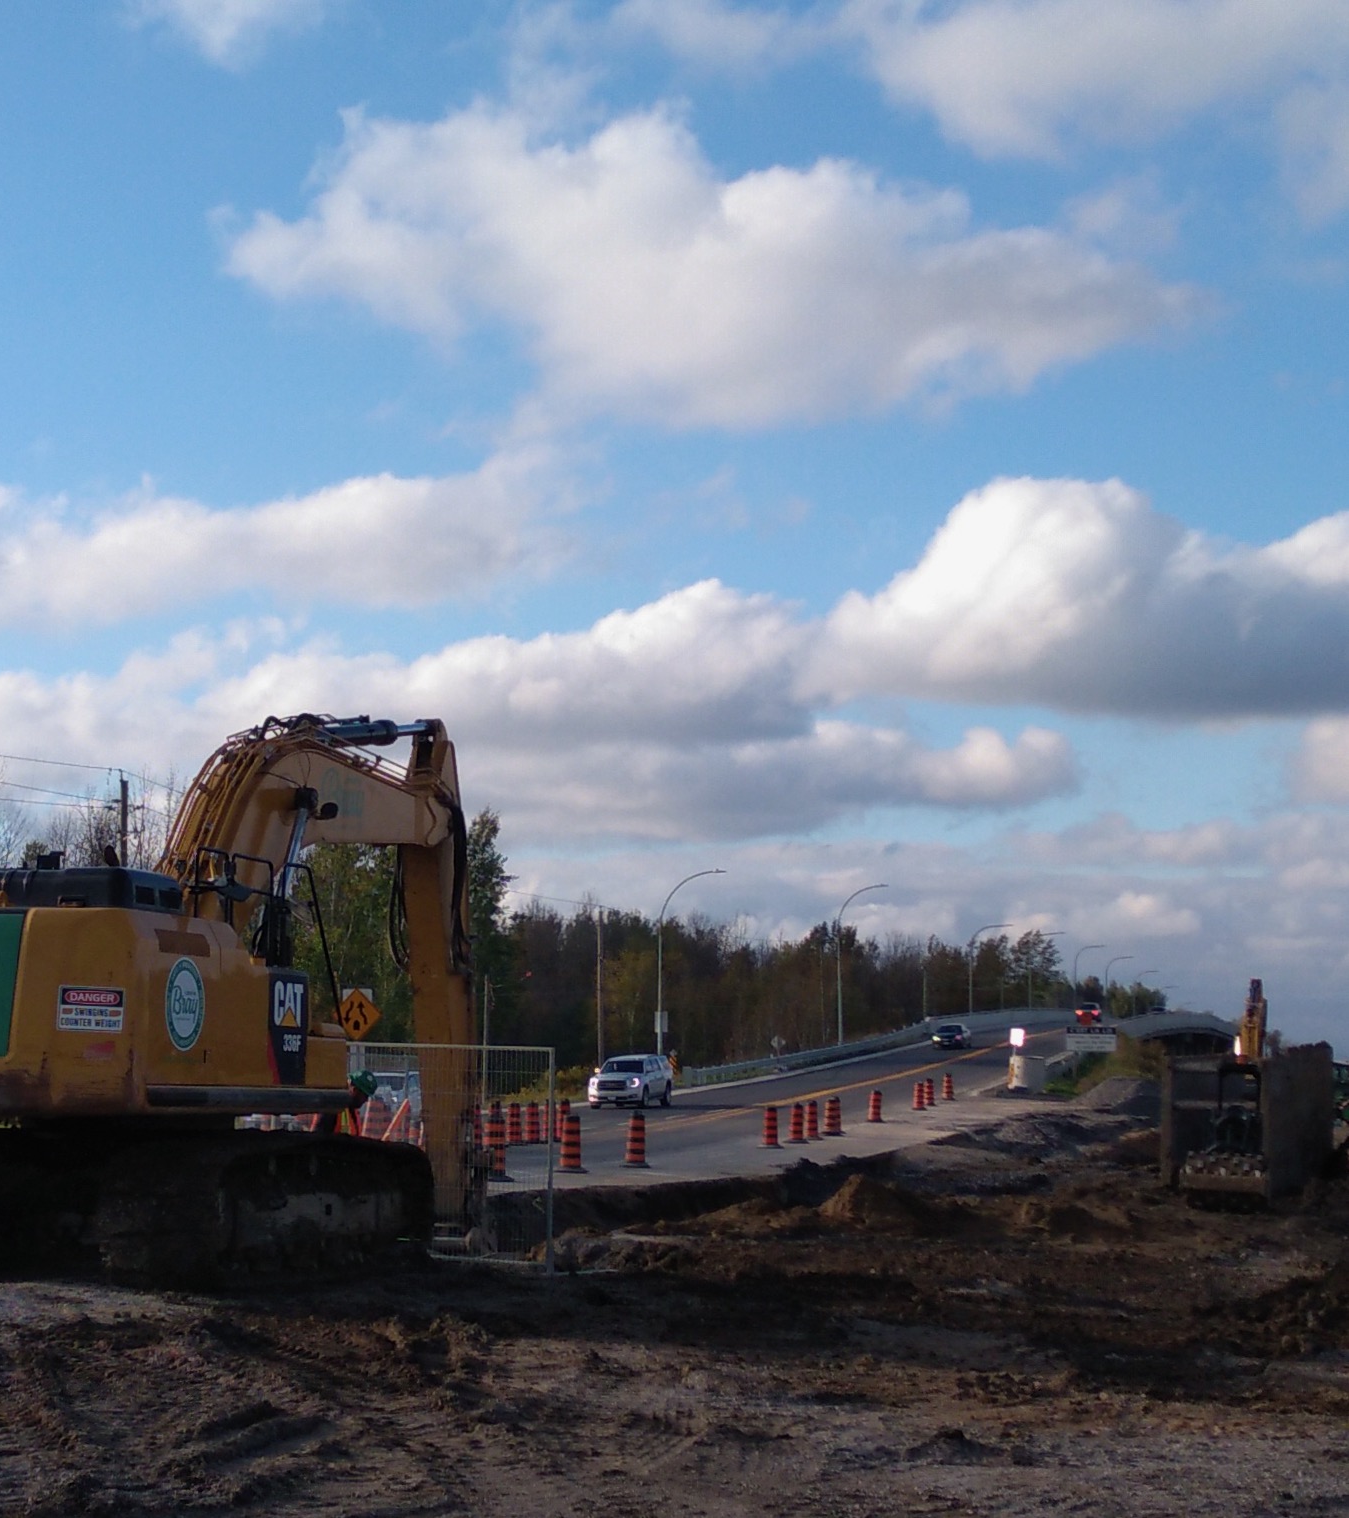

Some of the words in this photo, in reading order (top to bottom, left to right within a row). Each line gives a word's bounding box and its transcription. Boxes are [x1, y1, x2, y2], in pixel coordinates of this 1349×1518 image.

[70, 992, 115, 1003] DANGER
[173, 985, 198, 1024] Bray
[274, 980, 304, 1028] CAT
[61, 1017, 92, 1027] COUNTER
[283, 1033, 302, 1053] 336F
